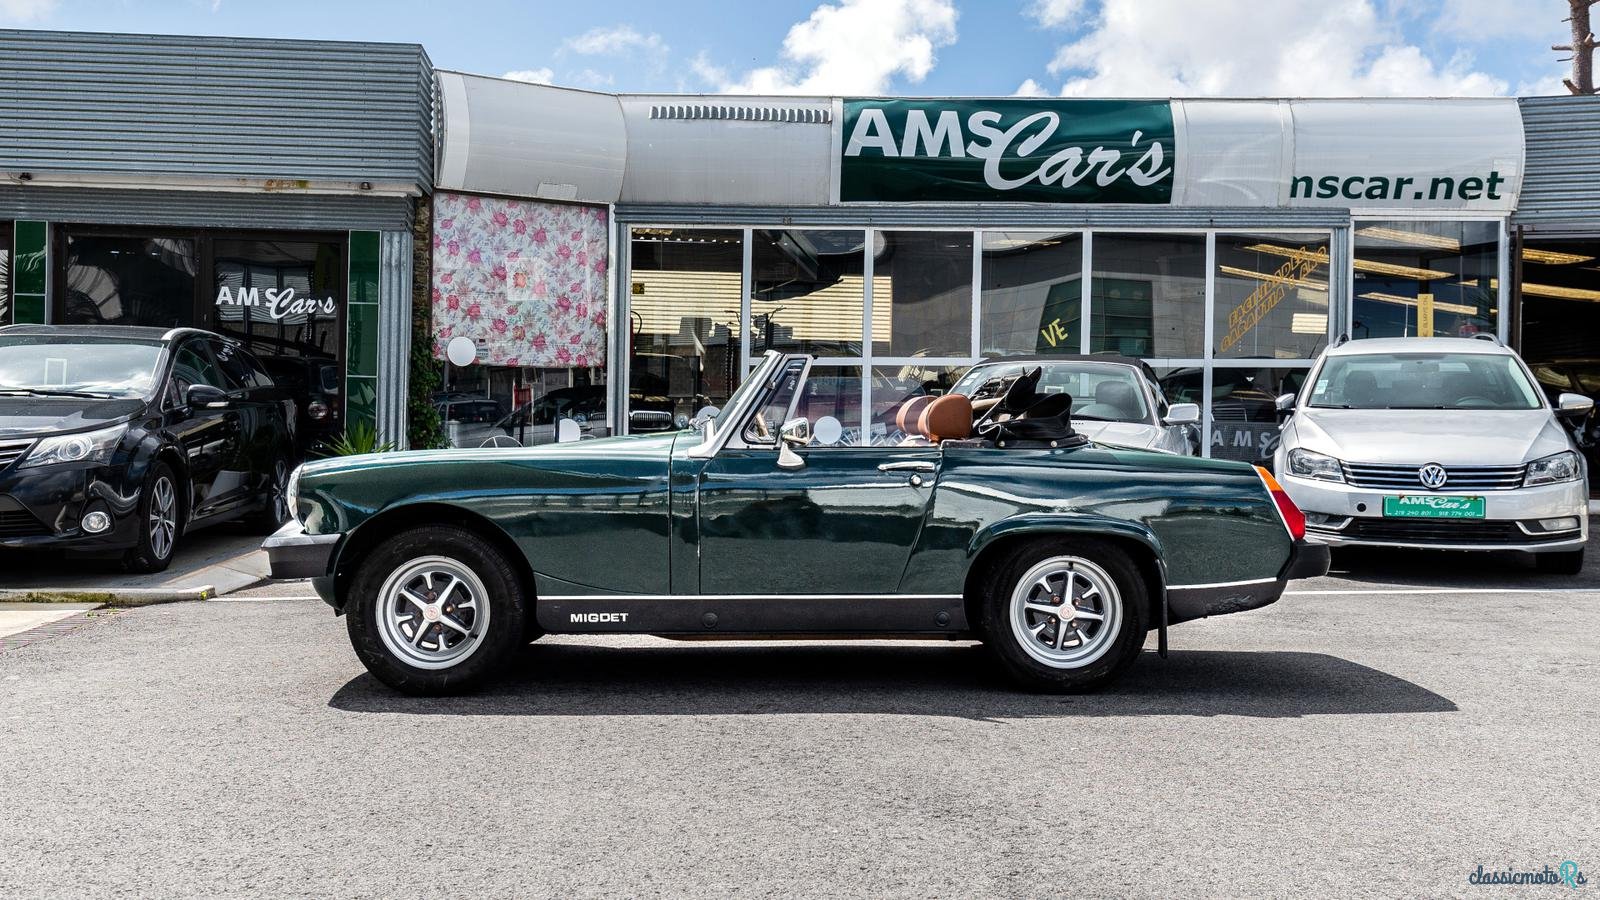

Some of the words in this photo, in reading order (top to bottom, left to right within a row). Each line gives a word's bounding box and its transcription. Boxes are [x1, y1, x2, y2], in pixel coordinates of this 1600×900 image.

[844, 108, 1004, 159] AMS
[983, 111, 1171, 191] Car's
[215, 286, 278, 306] AMS
[270, 288, 336, 319] Car's
[1041, 318, 1068, 347] VE
[1399, 497, 1433, 505] AMS
[570, 612, 629, 623] MIGDET
